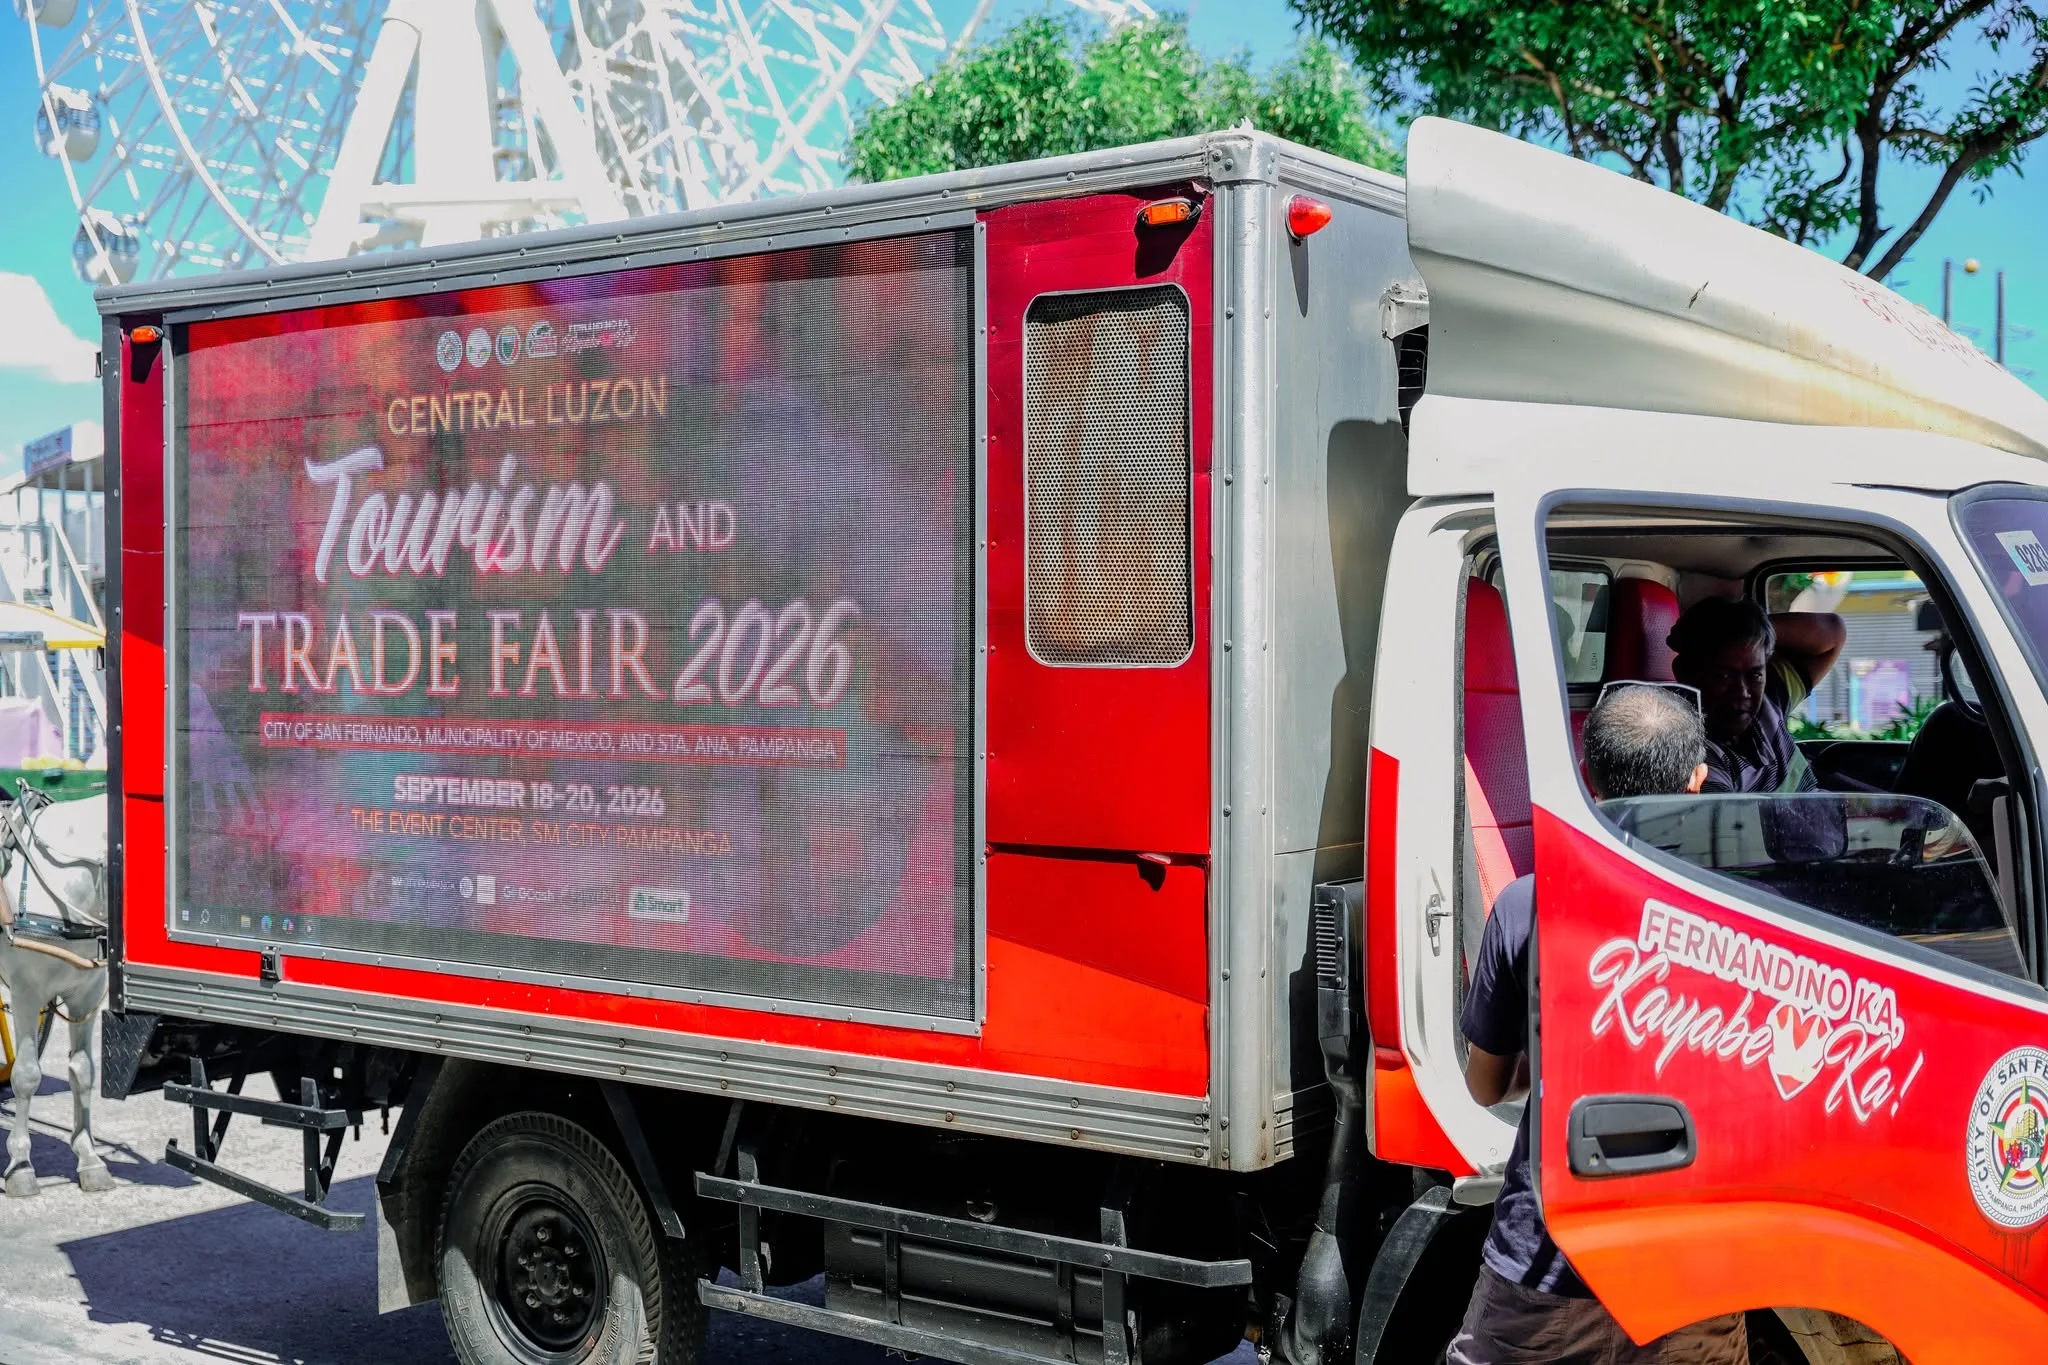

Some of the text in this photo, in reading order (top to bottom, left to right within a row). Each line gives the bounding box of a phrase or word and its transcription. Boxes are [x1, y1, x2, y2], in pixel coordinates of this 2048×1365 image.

[388, 376, 667, 434] CENTRAL LUZON
[304, 446, 624, 583] Tourism
[647, 501, 736, 551] AND
[237, 598, 864, 706] TRADE FAIR 2026
[263, 721, 291, 740] CITY
[295, 722, 312, 740] OF
[315, 723, 342, 741] SAN
[345, 724, 422, 747] FERNANDO,
[424, 726, 523, 748] MUNICIPALITY
[526, 729, 548, 749] OF
[551, 730, 615, 752] MEXICO,
[618, 733, 651, 752] AND
[738, 736, 839, 760] PAMPANGA
[393, 775, 526, 808] SEPTEMBER
[607, 786, 665, 816] 2026
[351, 808, 732, 855] THE EVENT CENTER, SM CITY PAMPANGA
[646, 893, 685, 914] Smart
[1642, 902, 1904, 1048] FERNANDINO KA,
[1588, 938, 1925, 1126] Kayabe Ka!
[1998, 1057, 2028, 1085] SAN
[1981, 1086, 1995, 1116] OF
[1975, 1127, 1988, 1181] CITY
